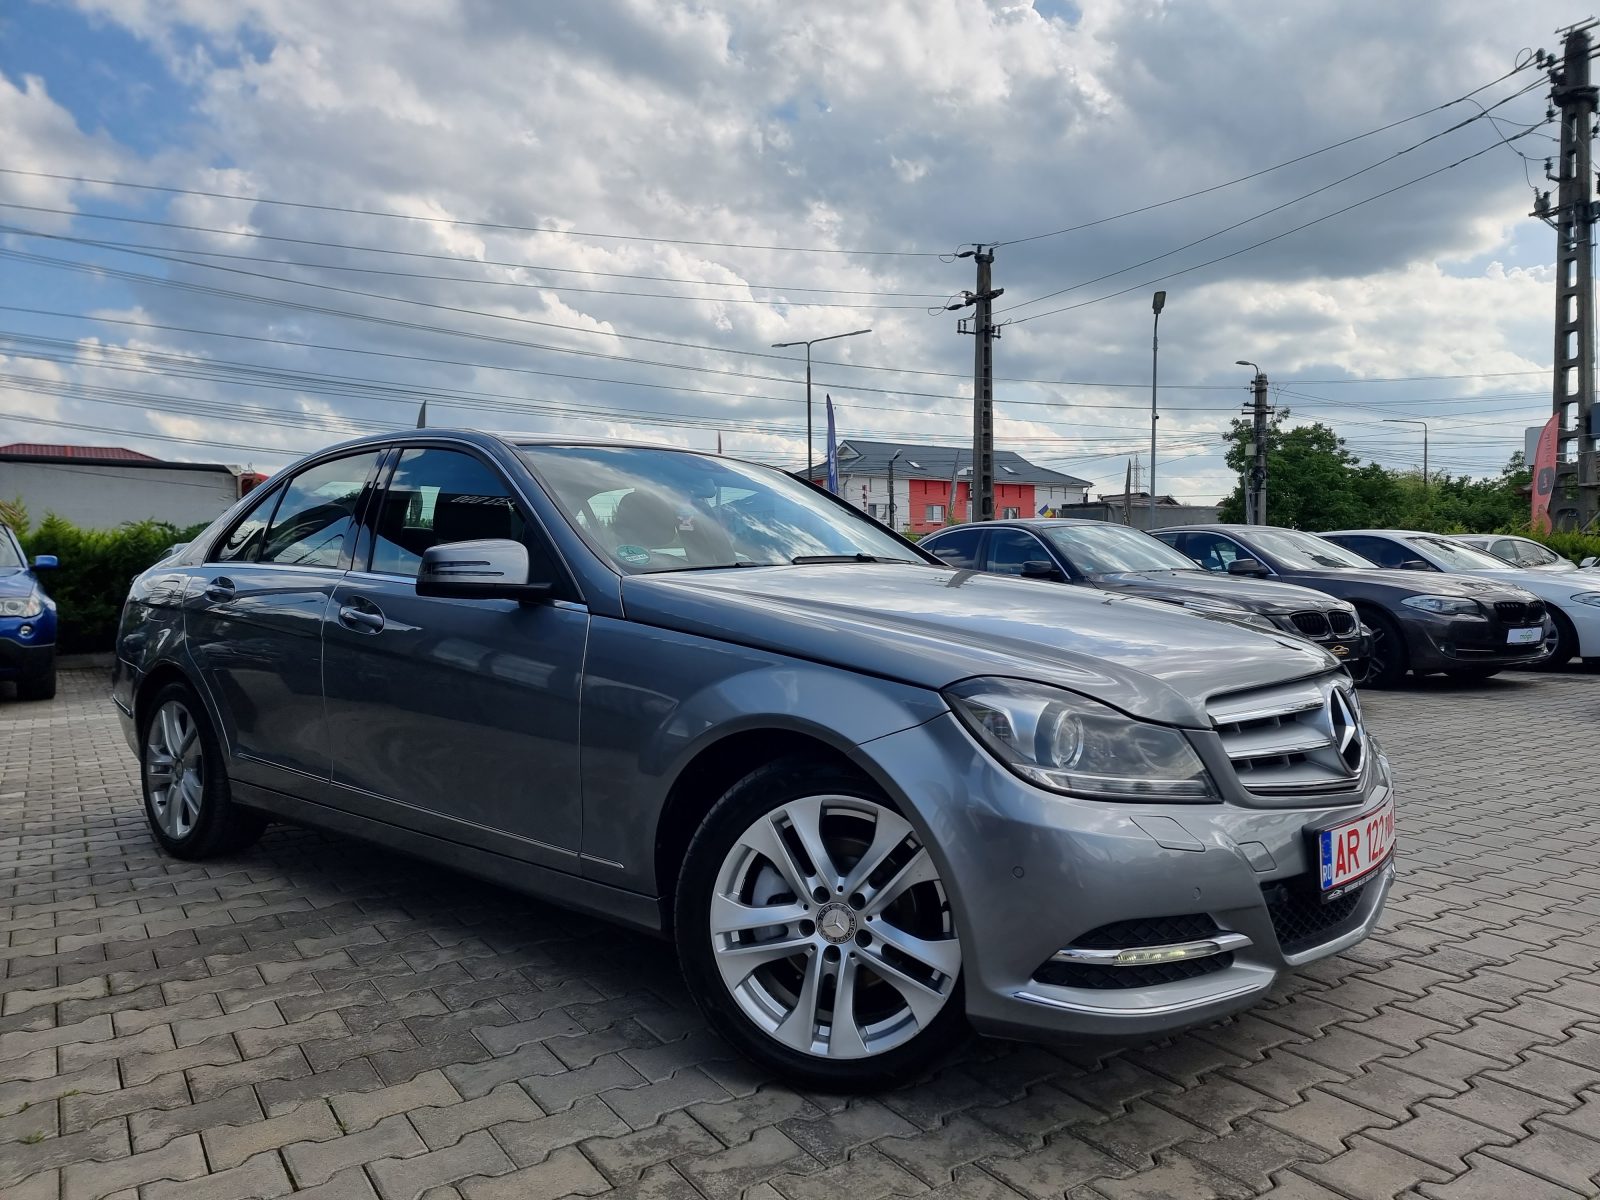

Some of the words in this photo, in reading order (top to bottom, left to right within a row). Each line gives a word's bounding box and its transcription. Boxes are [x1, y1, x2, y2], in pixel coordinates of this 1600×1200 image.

[1336, 829, 1360, 878] AR
[1367, 815, 1384, 863] 122
[1323, 863, 1332, 881] RO
